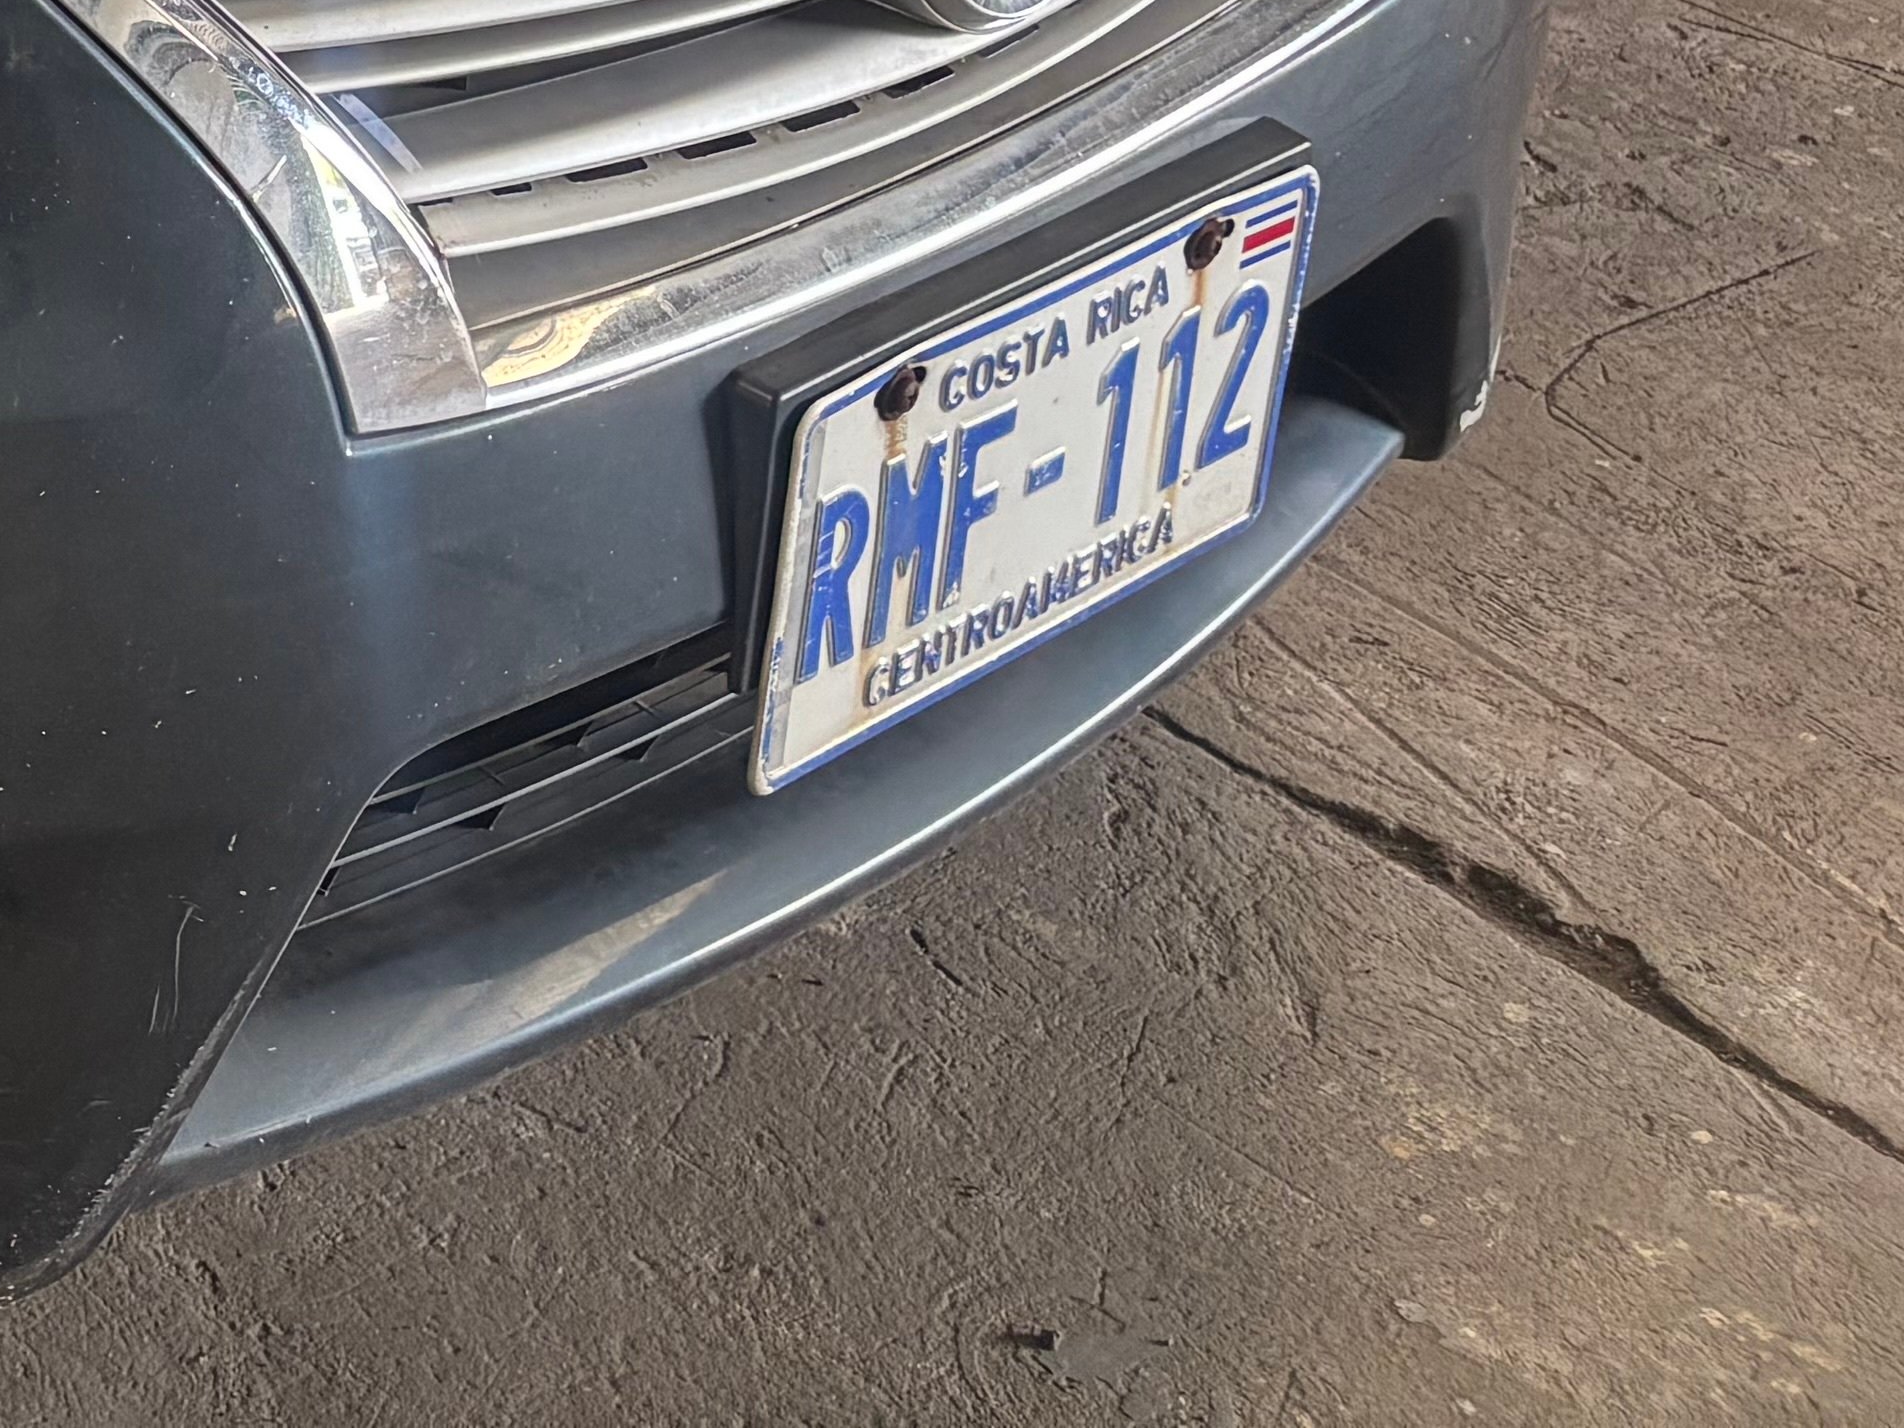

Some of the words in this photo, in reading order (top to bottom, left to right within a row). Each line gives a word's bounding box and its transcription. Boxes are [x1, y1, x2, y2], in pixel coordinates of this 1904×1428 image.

[938, 312, 1070, 412] COSTA
[1086, 260, 1171, 346] RICA
[793, 279, 1271, 686] RMF-112
[863, 502, 1175, 707] CENTROAMERICA
